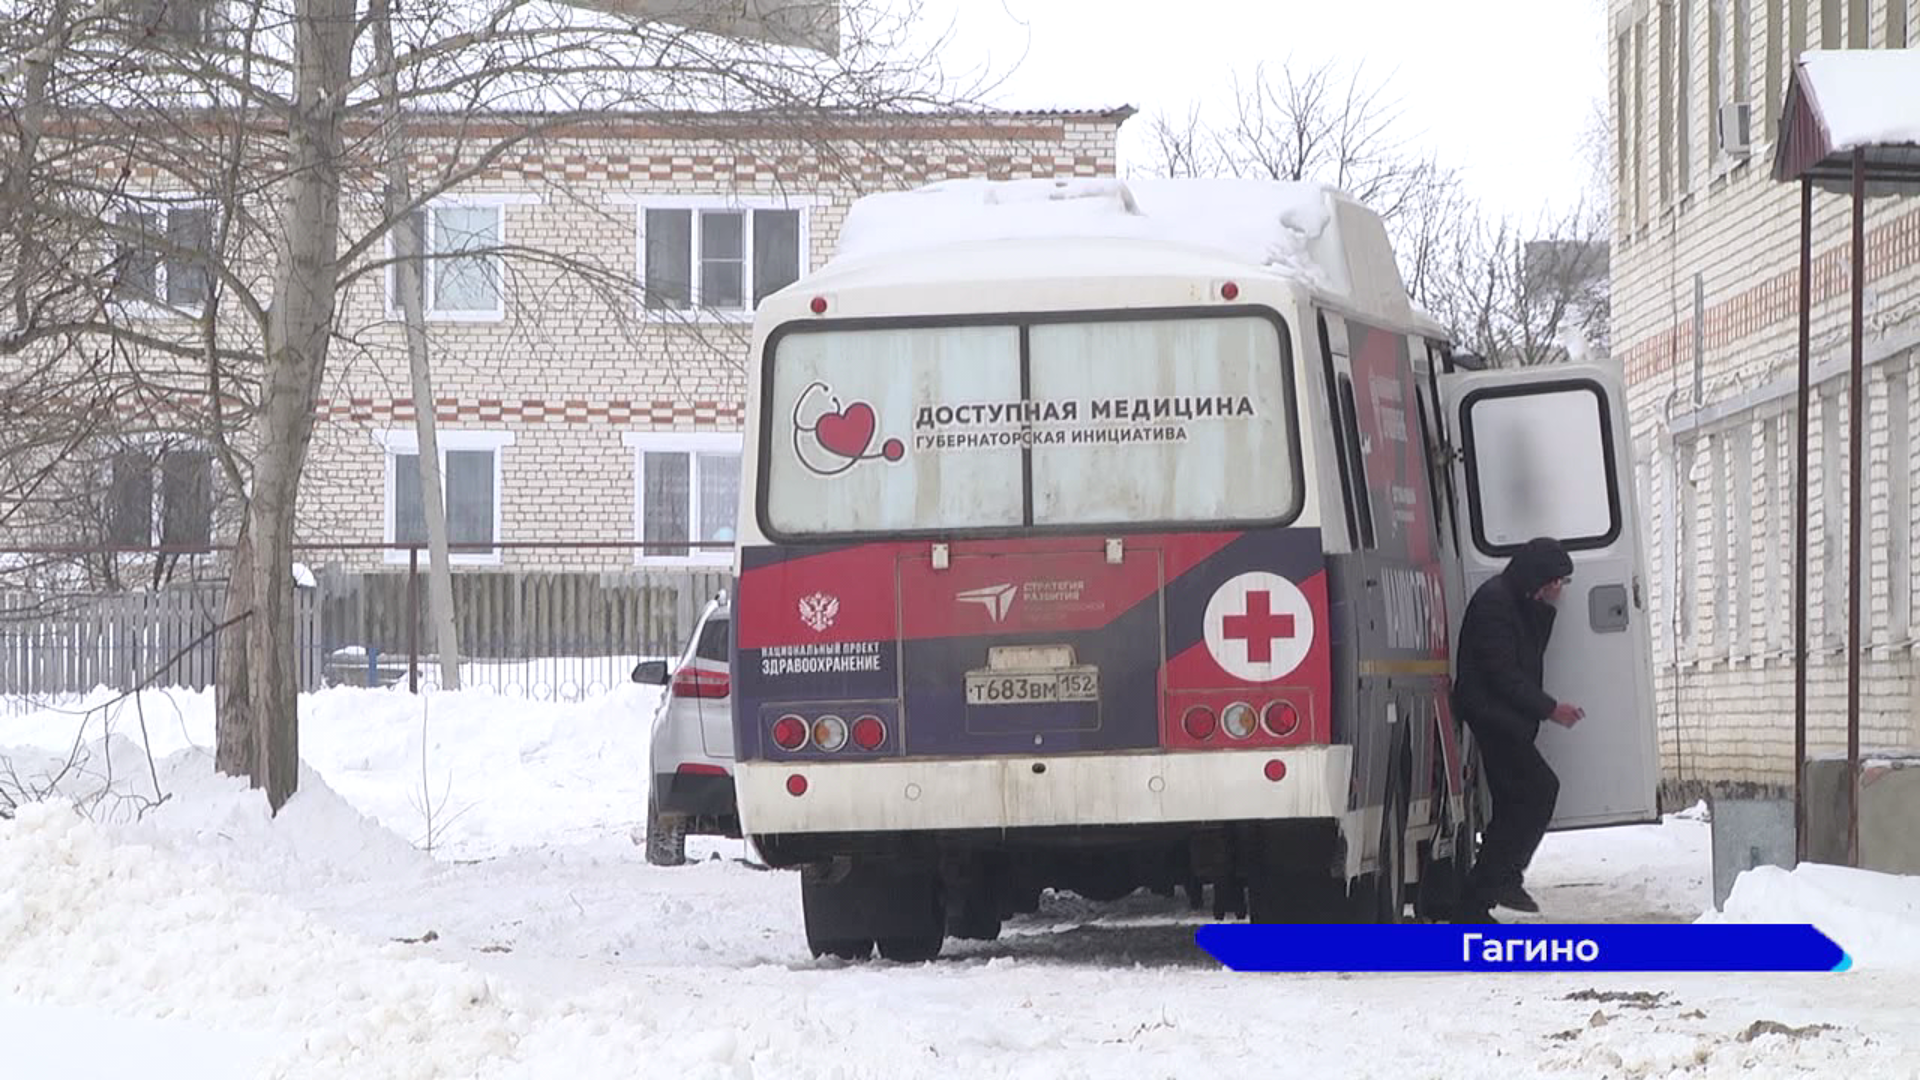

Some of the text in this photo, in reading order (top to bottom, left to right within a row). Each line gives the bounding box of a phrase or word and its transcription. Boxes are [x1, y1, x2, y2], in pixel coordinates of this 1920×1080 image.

[915, 396, 1255, 430] ДОСТУПНАЯ МЕДИЦИНА
[916, 426, 1188, 450] ГУБЕРНАТОРСКАЯ ИНИЦИАТИВА
[761, 655, 881, 676] ЗДРАВООХРАНЕНИЕ
[974, 675, 1093, 700] Т683ВМ 152
